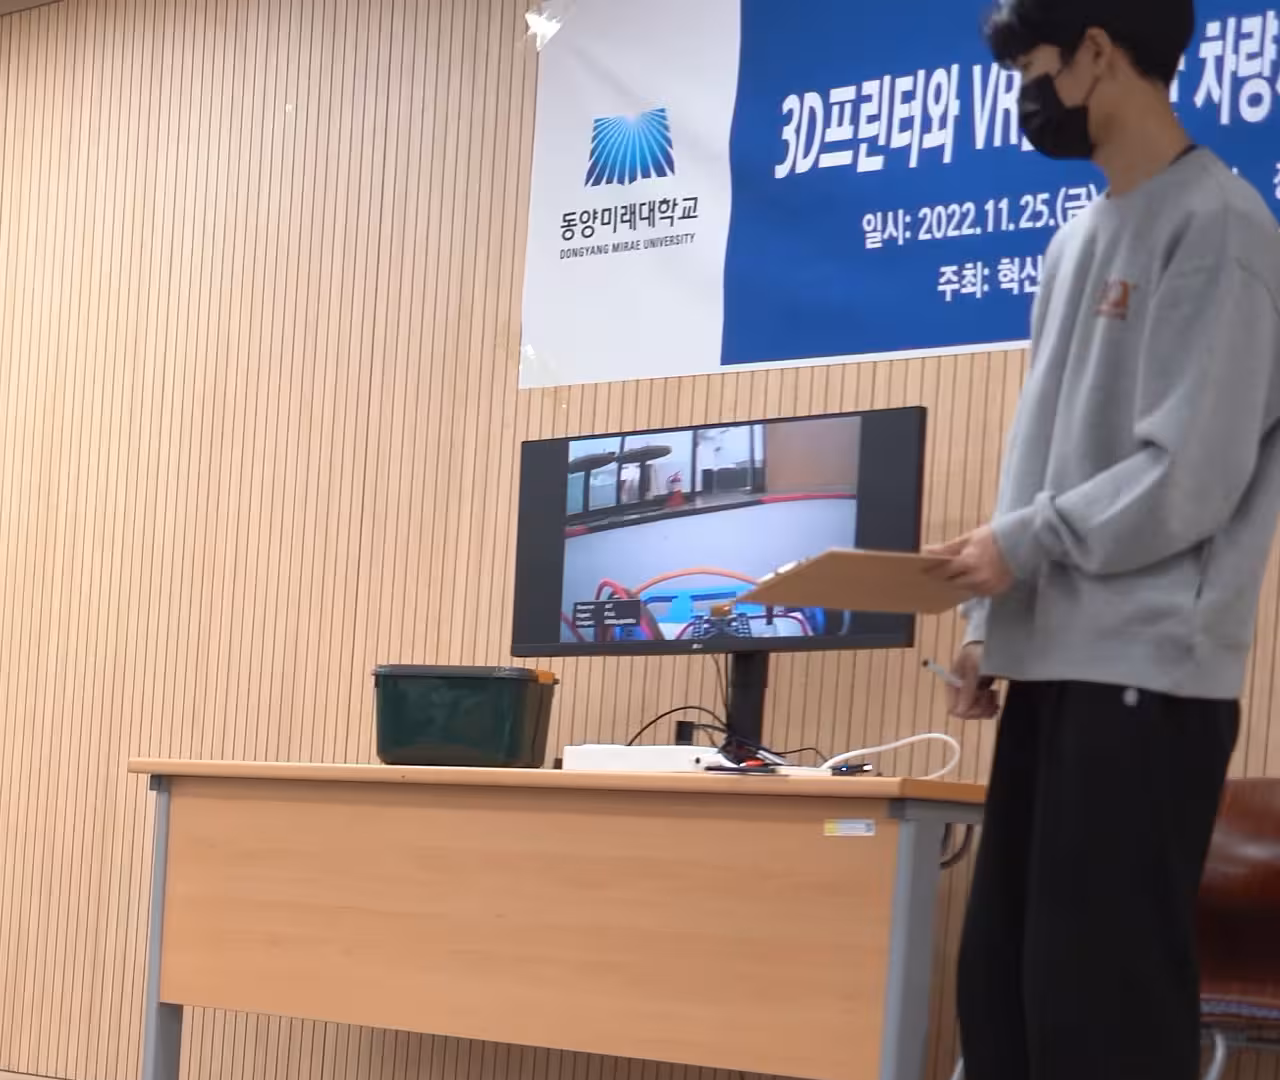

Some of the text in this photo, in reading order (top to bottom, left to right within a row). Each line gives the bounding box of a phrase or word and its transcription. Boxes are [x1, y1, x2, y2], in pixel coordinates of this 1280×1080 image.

[774, 63, 960, 179] 3D프린터와
[972, 62, 1036, 151] VR
[1193, 10, 1280, 124] 차량
[560, 197, 699, 241] 동양미래대학교
[862, 208, 912, 249] 일시:
[560, 233, 696, 260] DONGYANG MIRAE UNIVERSITY
[937, 261, 990, 301] 주최:
